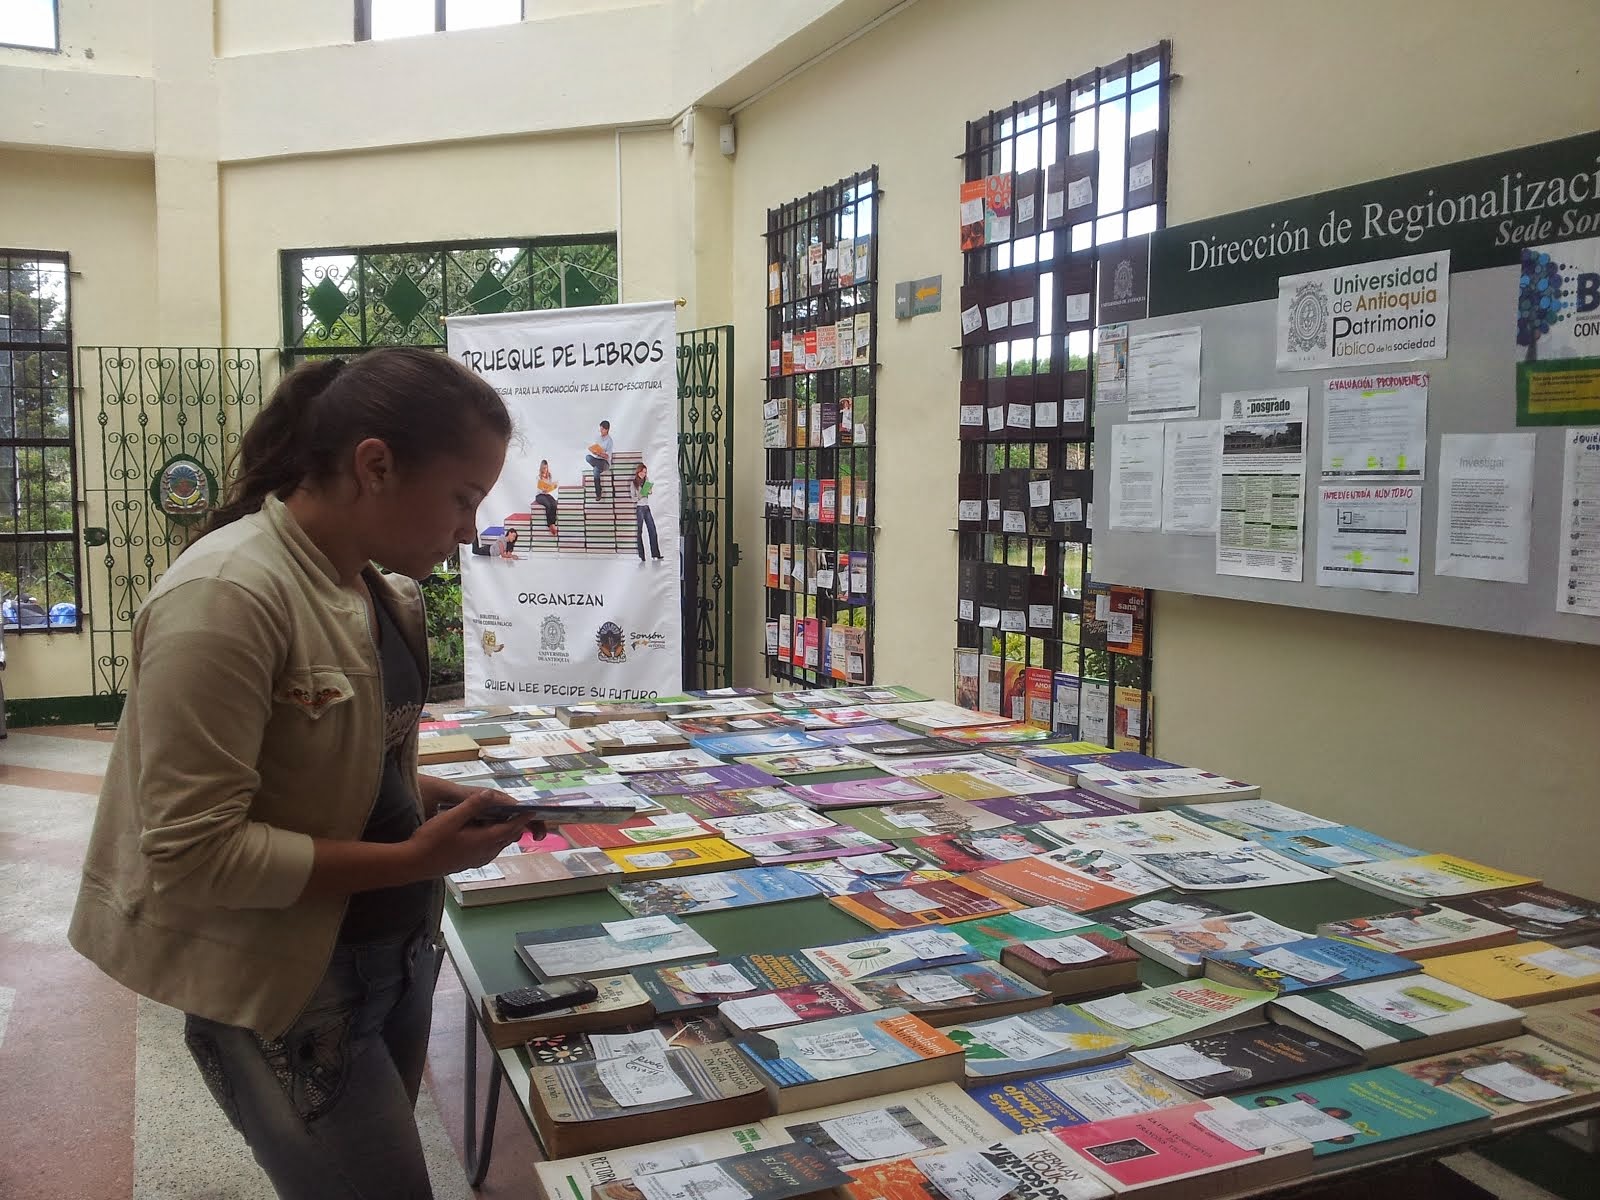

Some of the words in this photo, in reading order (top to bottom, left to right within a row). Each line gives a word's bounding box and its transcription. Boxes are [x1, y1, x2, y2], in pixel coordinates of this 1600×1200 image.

[1188, 219, 1310, 272] Dirección
[1318, 210, 1352, 248] de
[1494, 215, 1552, 246] Sede
[1333, 262, 1438, 295] Universidad
[1333, 299, 1352, 314] de
[1356, 286, 1437, 313] Antioquia
[1332, 309, 1436, 357] Patrimonio
[1376, 345, 1385, 353] de
[1393, 337, 1436, 350] sociedad
[462, 345, 545, 373] TRUEQUE
[552, 344, 577, 368] DE
[583, 340, 664, 367] LIBROS
[514, 386, 531, 396] PARA
[532, 386, 540, 394] LA
[541, 381, 579, 395] PROMOCIÓN
[580, 384, 589, 393] DE
[590, 383, 599, 392] LA
[601, 380, 663, 392] LECTO-ESCRITURA
[1250, 399, 1291, 414] posgrado
[517, 592, 604, 607] ORGANIZAN
[1117, 603, 1137, 611] sana
[630, 632, 666, 640] Sonsón
[484, 678, 515, 693] QUIEN
[518, 682, 540, 694] LEE
[543, 683, 586, 696] DECIDE
[590, 686, 606, 698] SU
[609, 688, 658, 700] FUTURO
[796, 1004, 809, 1012] en
[888, 1016, 913, 1026] El
[899, 1023, 946, 1053] Periodismo
[704, 1058, 715, 1066] EN
[710, 1066, 727, 1083] RUSIA
[710, 1048, 722, 1057] DEL
[717, 1057, 749, 1090] CAPITALISMO
[728, 1053, 759, 1085] DESARROLLO
[1002, 1086, 1058, 1126] Trabajo
[761, 1155, 787, 1165] El
[988, 1142, 1050, 1188] VIENTOS
[1023, 1152, 1069, 1185] WOUK
[1036, 1148, 1084, 1181] HERMAN
[769, 1165, 800, 1186] viajero
